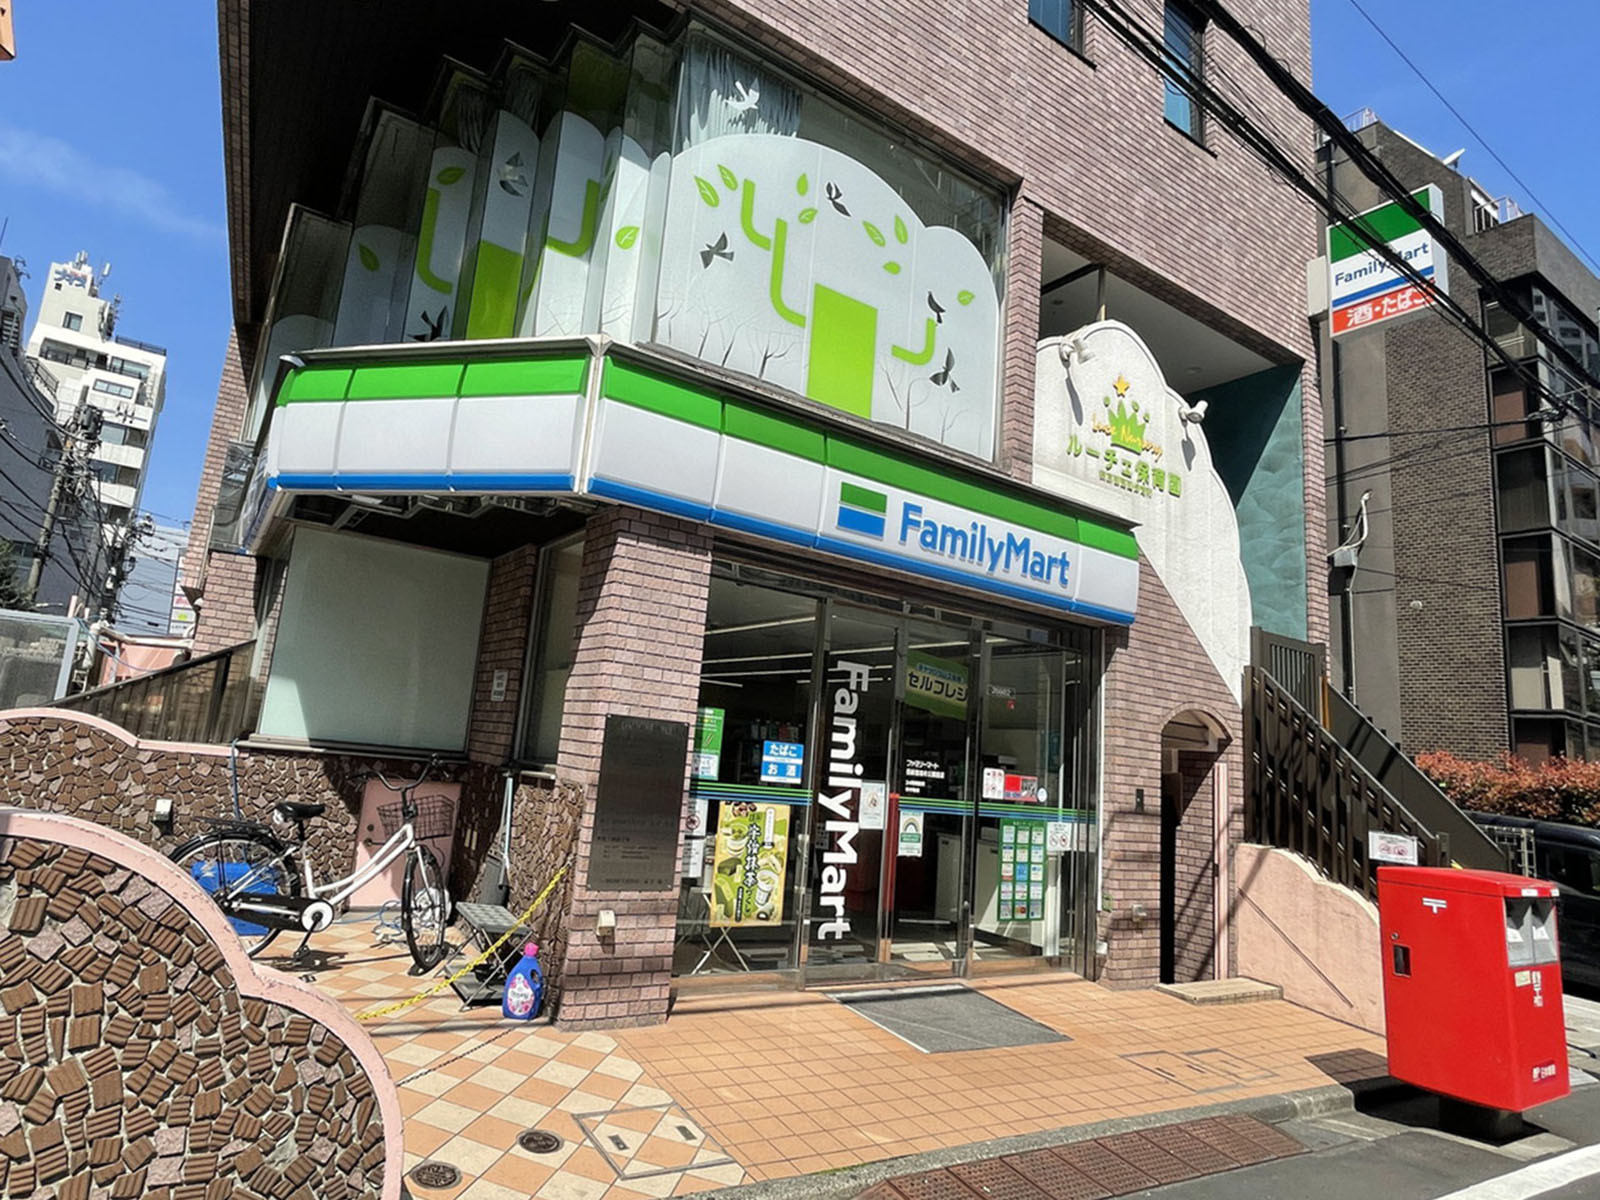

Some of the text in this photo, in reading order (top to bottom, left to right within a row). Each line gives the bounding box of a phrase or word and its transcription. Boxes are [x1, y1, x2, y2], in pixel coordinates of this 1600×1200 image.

[1335, 242, 1428, 286] Familyart
[900, 501, 1071, 588] FamilyMart
[770, 743, 798, 757] たばこ
[817, 660, 871, 941] FamilyMart
